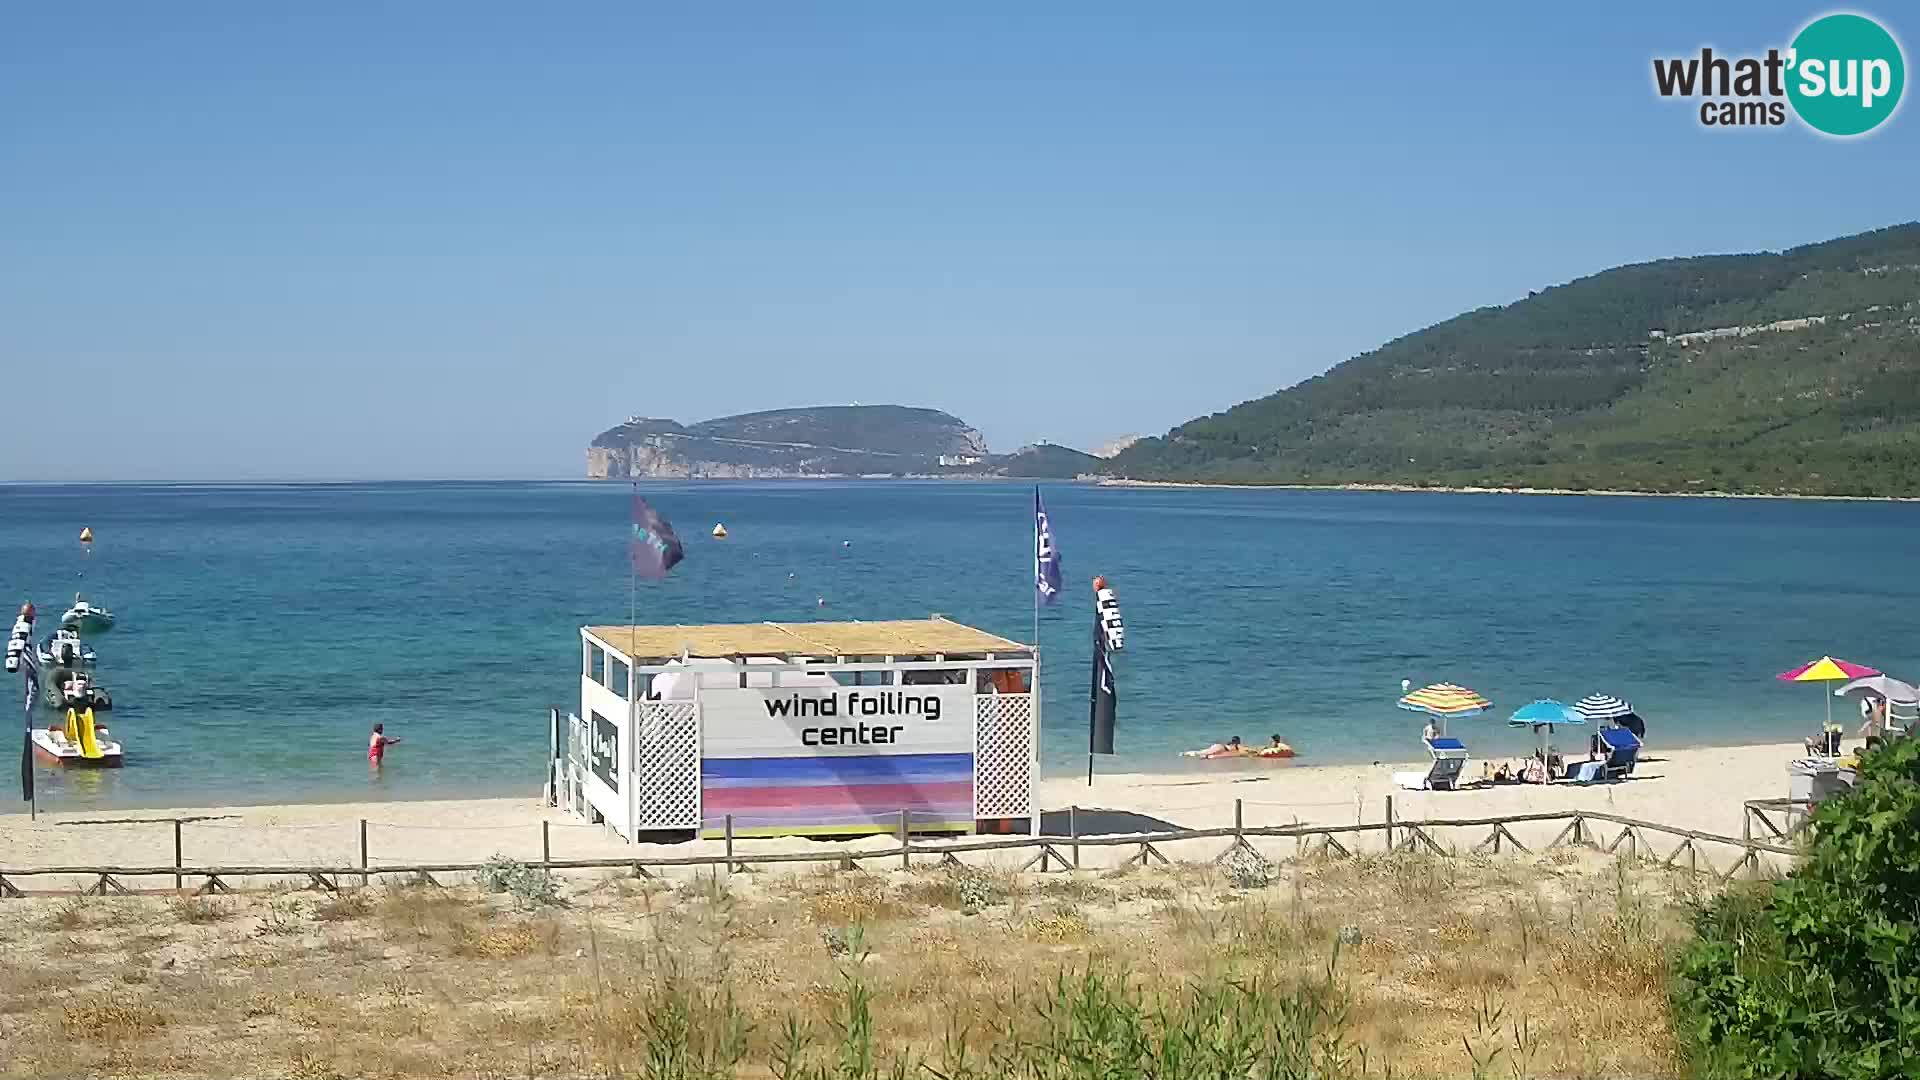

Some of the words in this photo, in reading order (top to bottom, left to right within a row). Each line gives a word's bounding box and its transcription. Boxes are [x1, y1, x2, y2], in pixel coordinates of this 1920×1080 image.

[764, 693, 838, 717] wind
[849, 692, 941, 720] foiling
[802, 722, 903, 745] center
